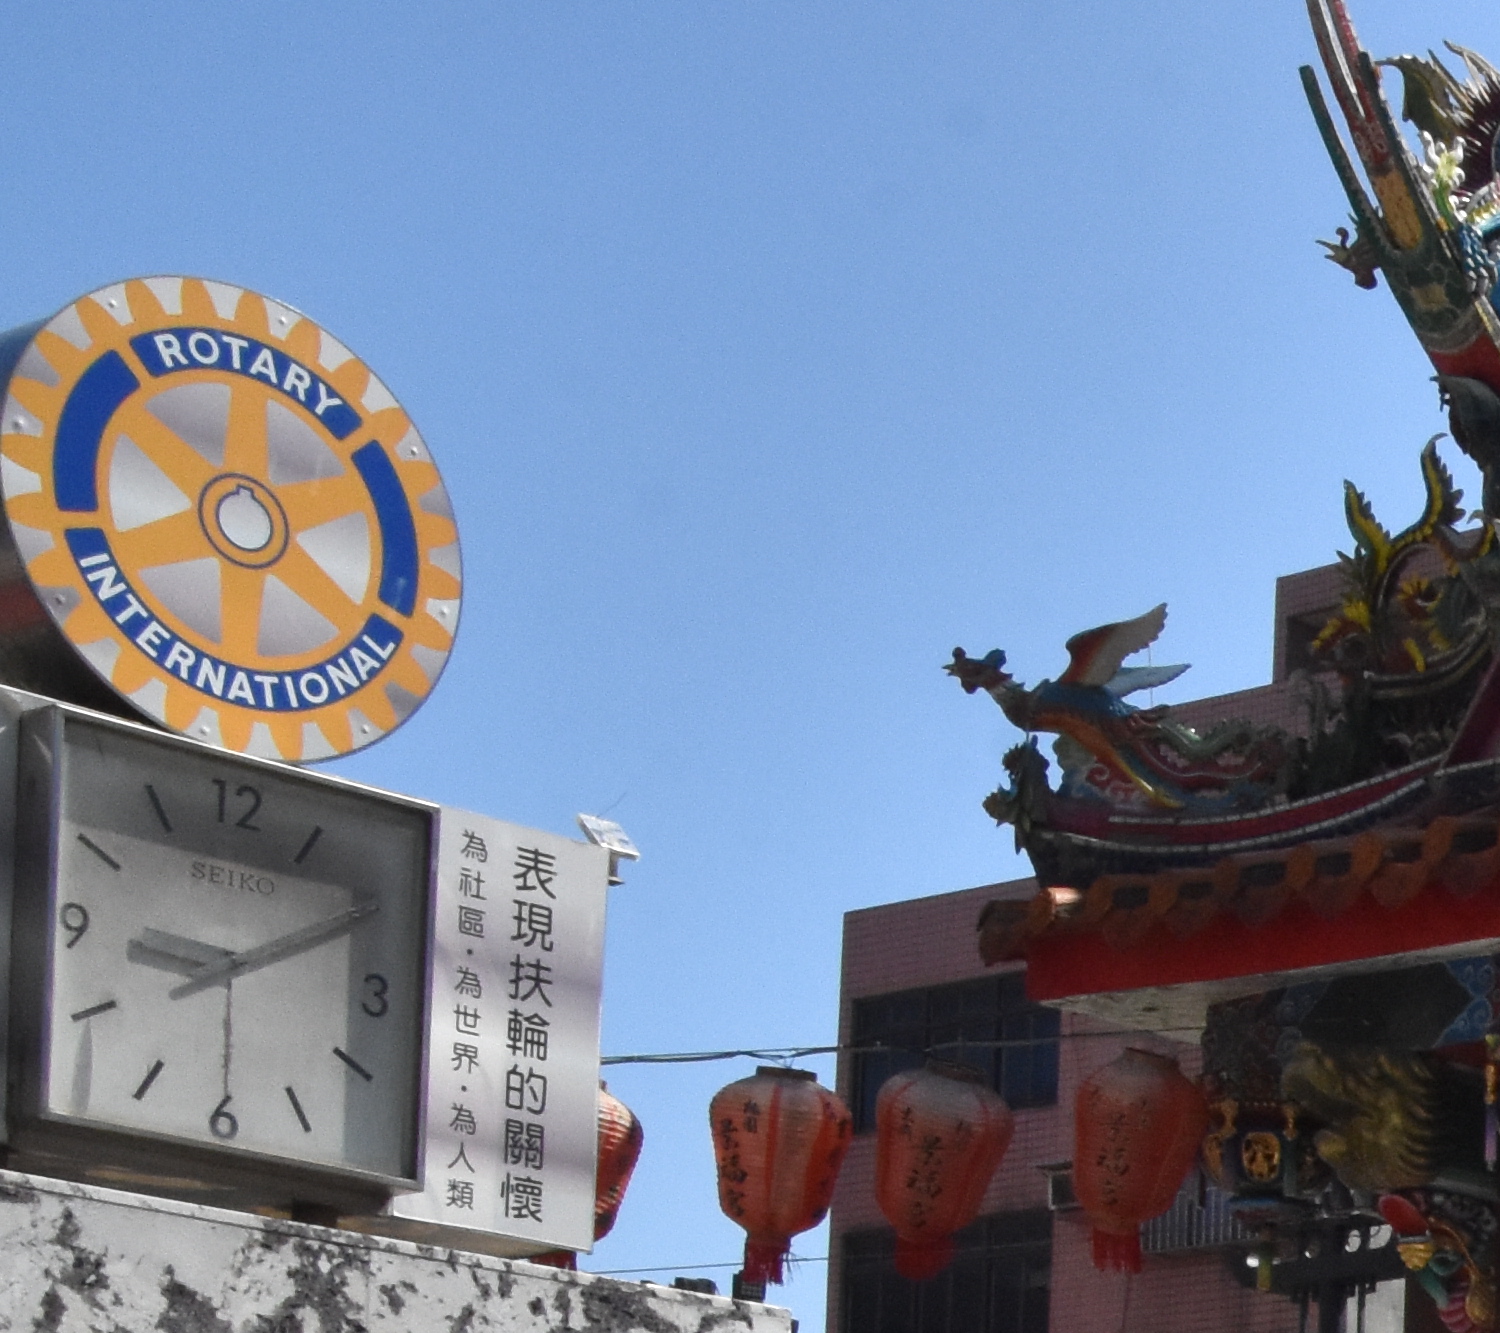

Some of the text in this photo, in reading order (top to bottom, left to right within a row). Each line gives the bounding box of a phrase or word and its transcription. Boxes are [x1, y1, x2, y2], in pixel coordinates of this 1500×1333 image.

[155, 328, 343, 420] ROTARY
[77, 550, 397, 707] INTERNATIONAL
[212, 779, 263, 831] 12
[190, 859, 278, 898] SEIKO
[58, 901, 90, 948] 9
[360, 972, 390, 1018] 3
[499, 845, 560, 1225] 表現扶輪的關懷
[209, 1095, 238, 1139] 6
